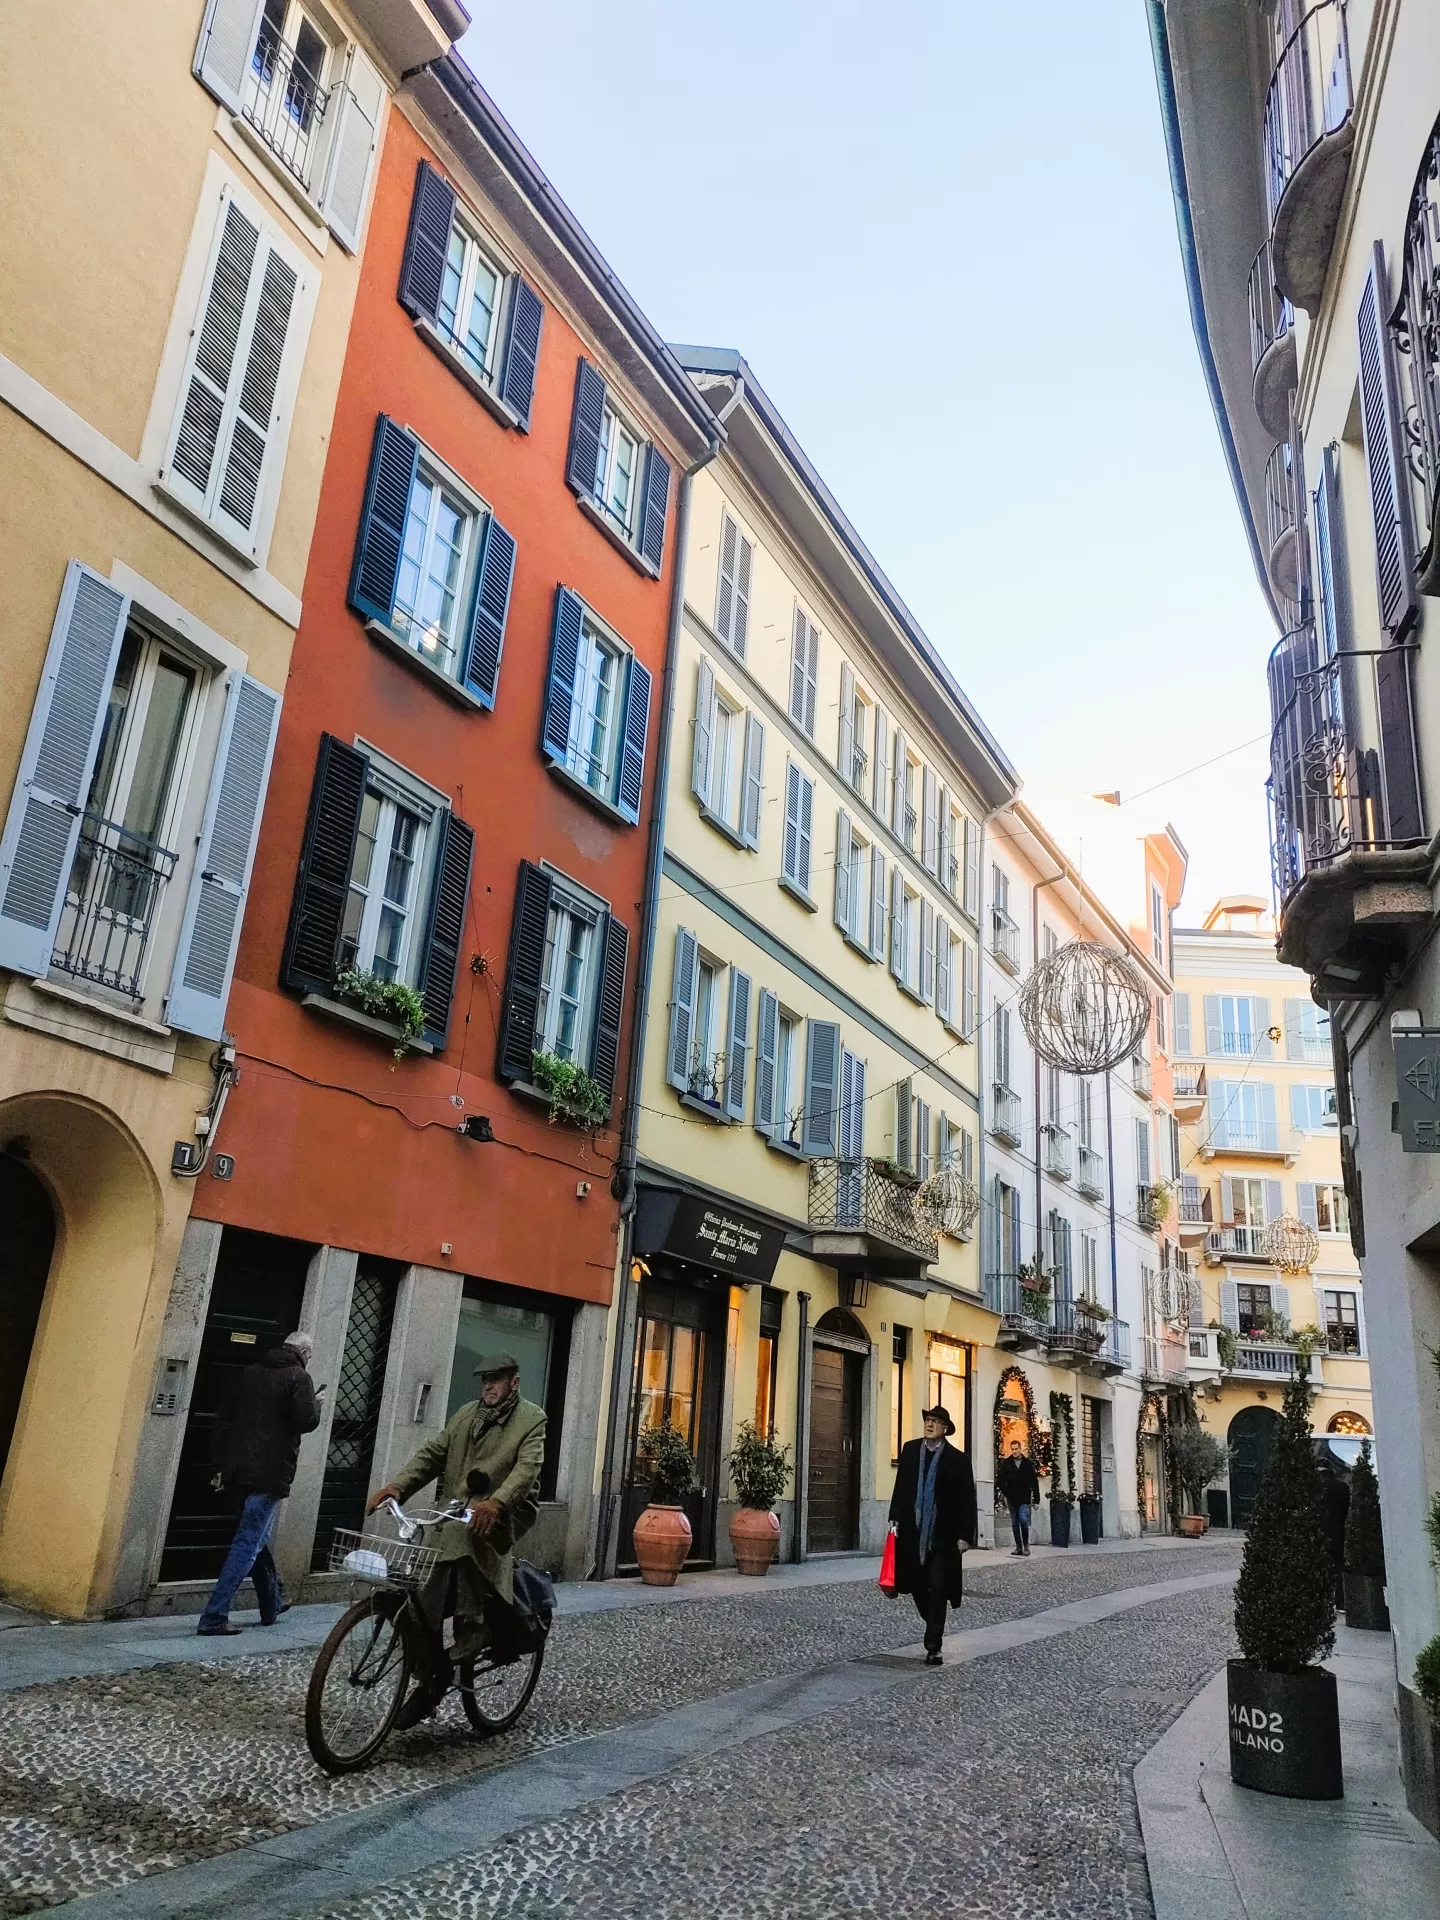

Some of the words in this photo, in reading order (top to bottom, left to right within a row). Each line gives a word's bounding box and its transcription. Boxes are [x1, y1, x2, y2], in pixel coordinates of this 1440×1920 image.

[181, 1146, 191, 1166] 7
[218, 1157, 228, 1176] 9
[695, 1222, 718, 1241] Santa
[716, 1230, 737, 1248] Maria
[735, 1235, 759, 1256] Novella
